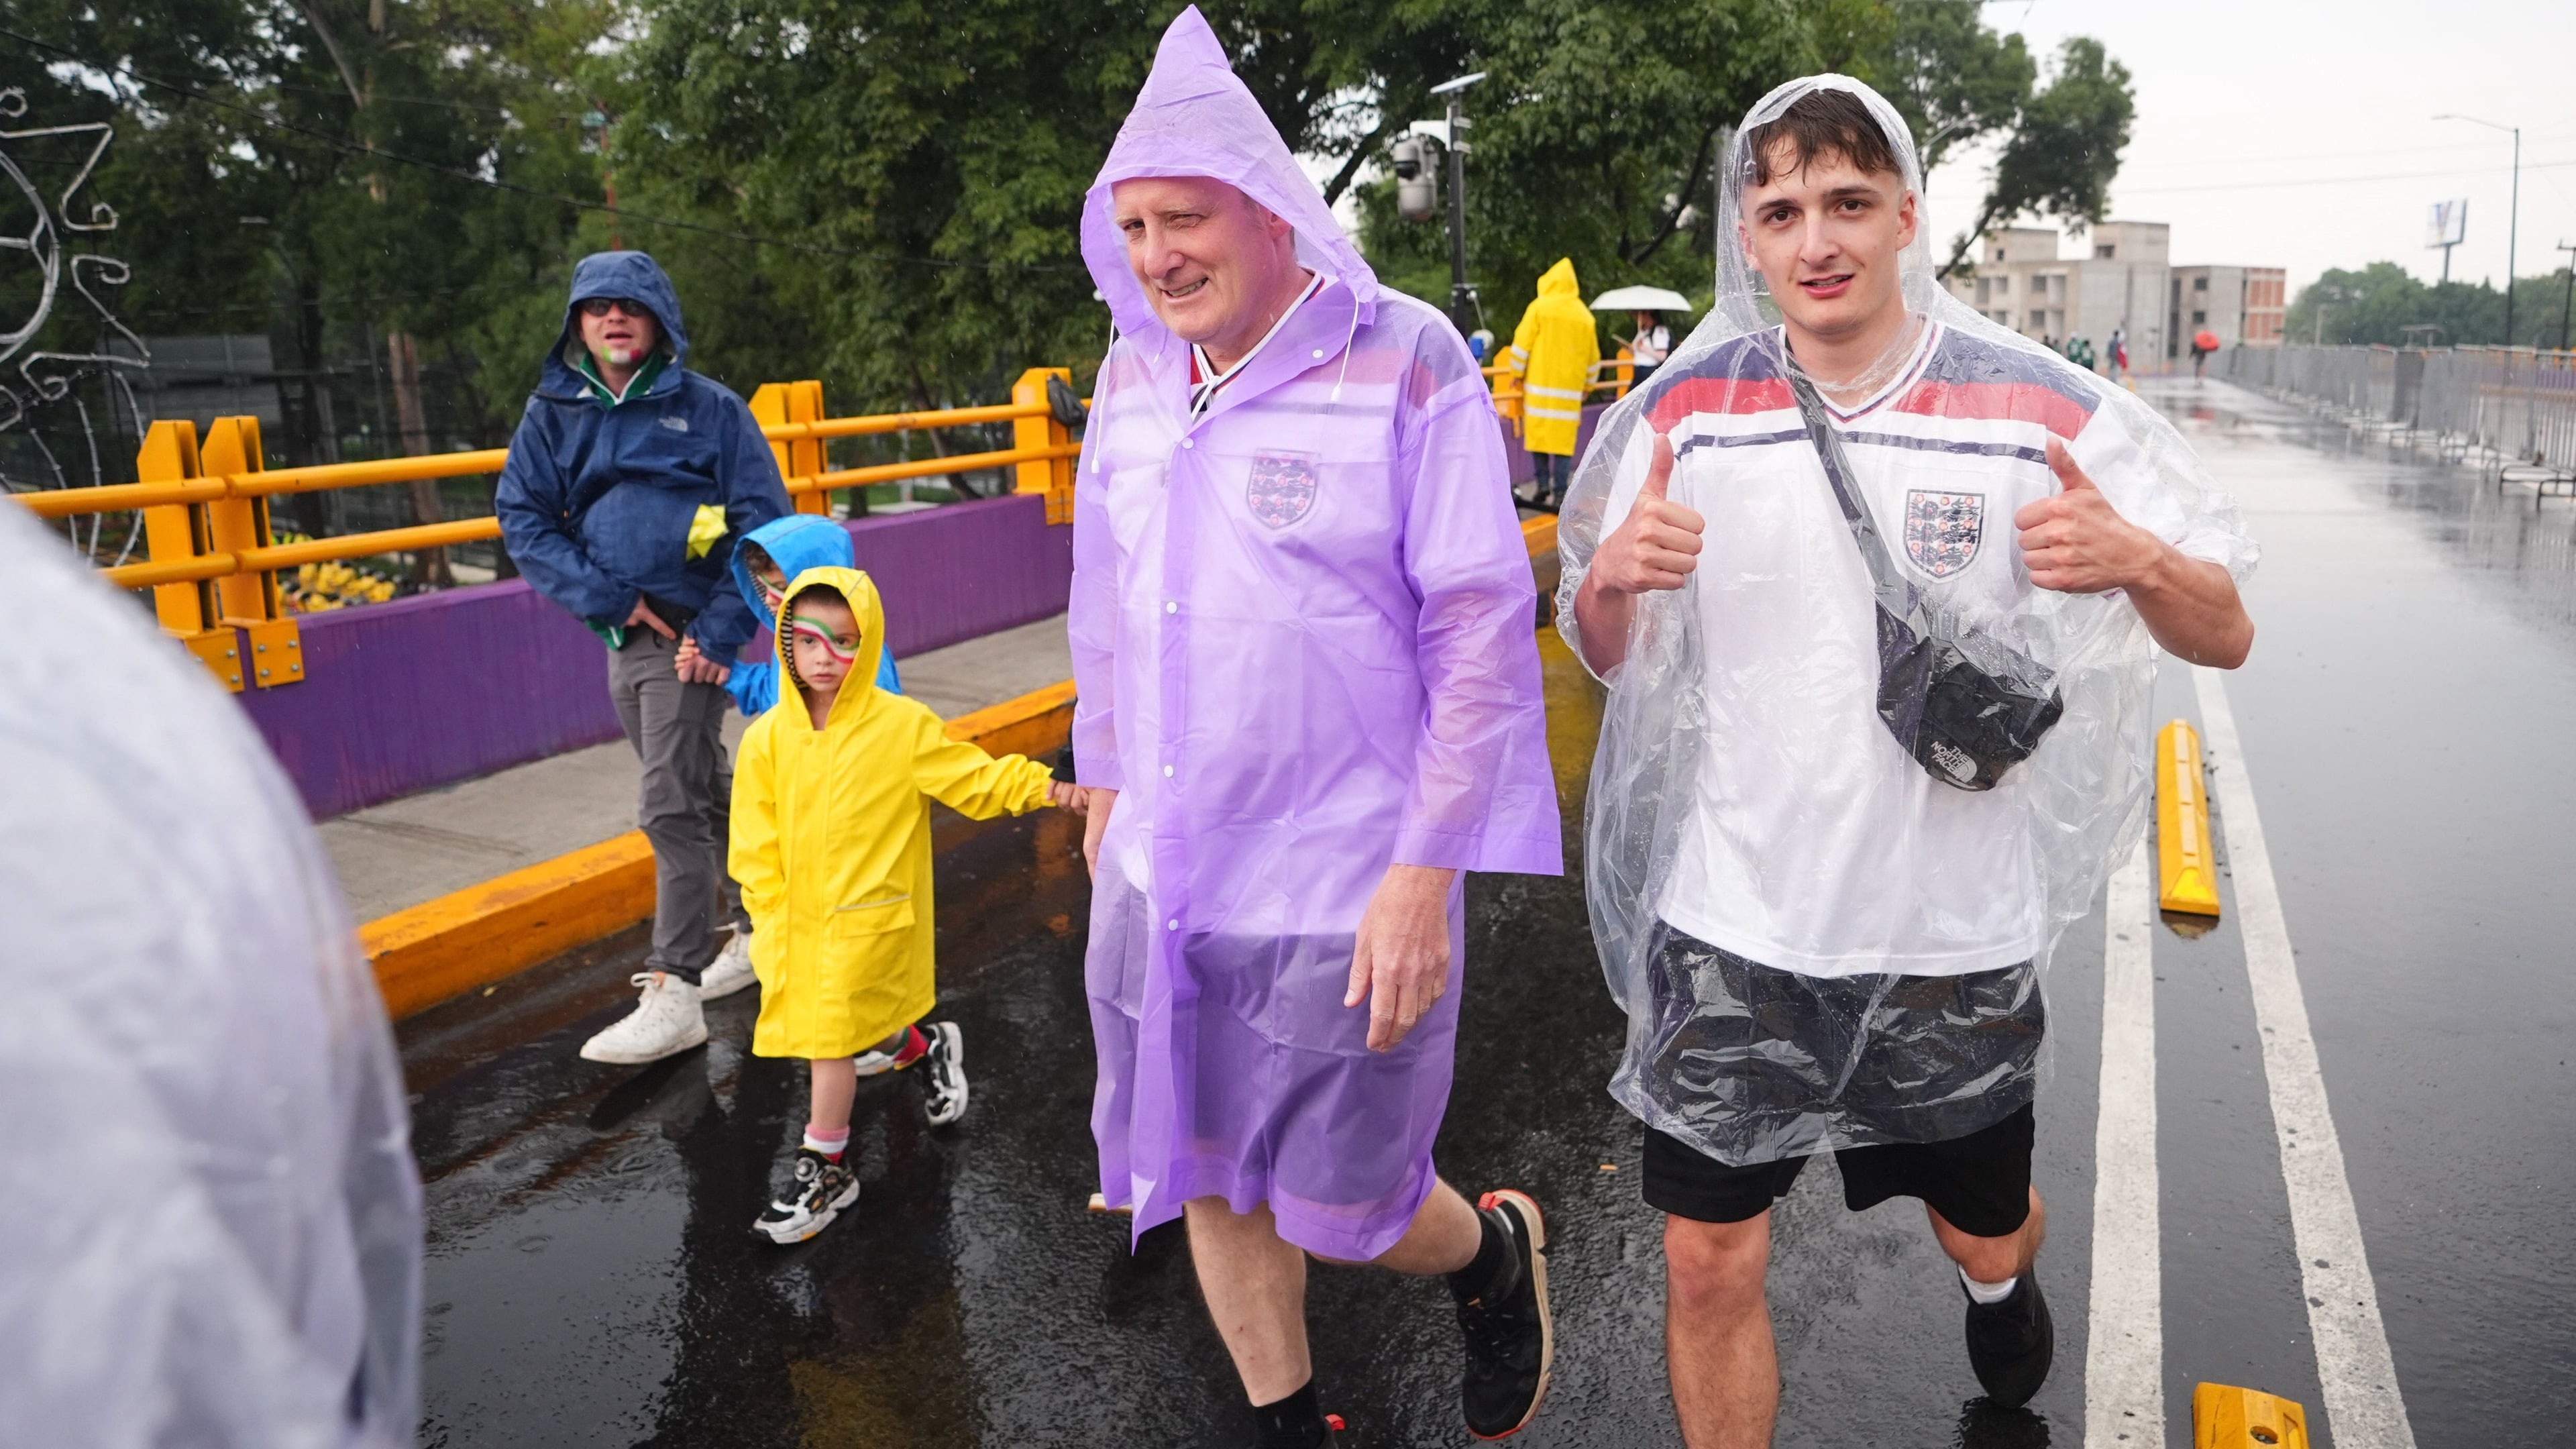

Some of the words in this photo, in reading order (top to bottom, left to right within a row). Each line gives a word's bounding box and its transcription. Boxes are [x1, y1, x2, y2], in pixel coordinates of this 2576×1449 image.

[1931, 741, 1964, 767] NORTH
[1931, 753, 1957, 774] FACE
[1951, 745, 1970, 763] THE
